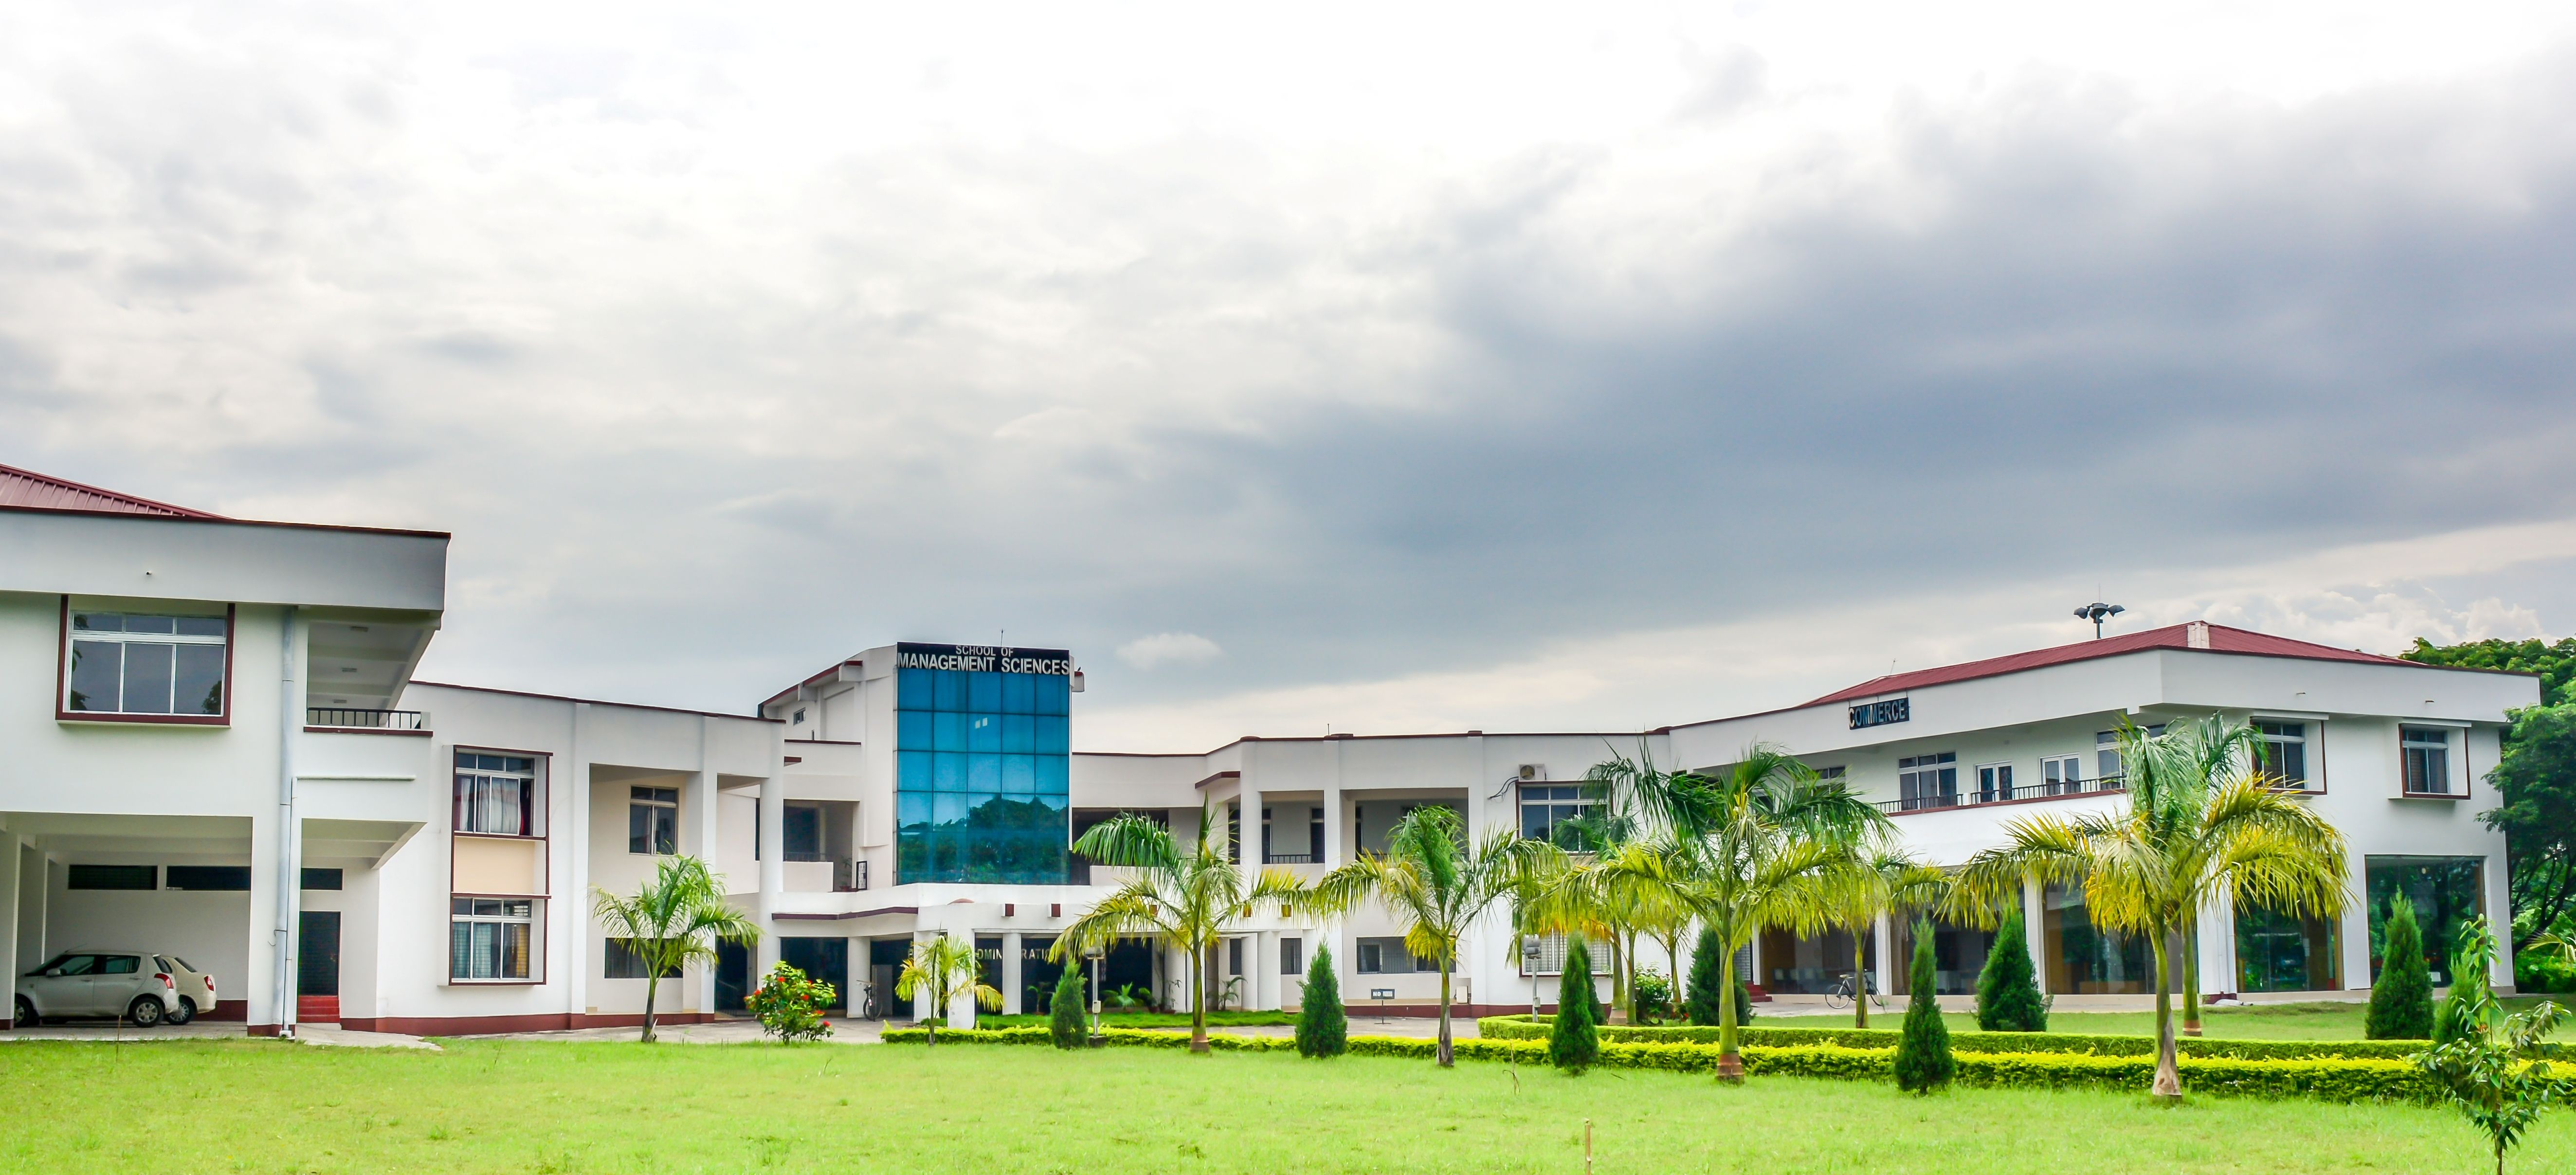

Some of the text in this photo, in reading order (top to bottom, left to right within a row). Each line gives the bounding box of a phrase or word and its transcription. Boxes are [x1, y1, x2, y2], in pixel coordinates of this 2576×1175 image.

[956, 646, 1014, 657] SCHOOL OF
[898, 652, 1070, 675] MANAGEMENT SCIENCES
[1849, 699, 1905, 727] COMMERCE
